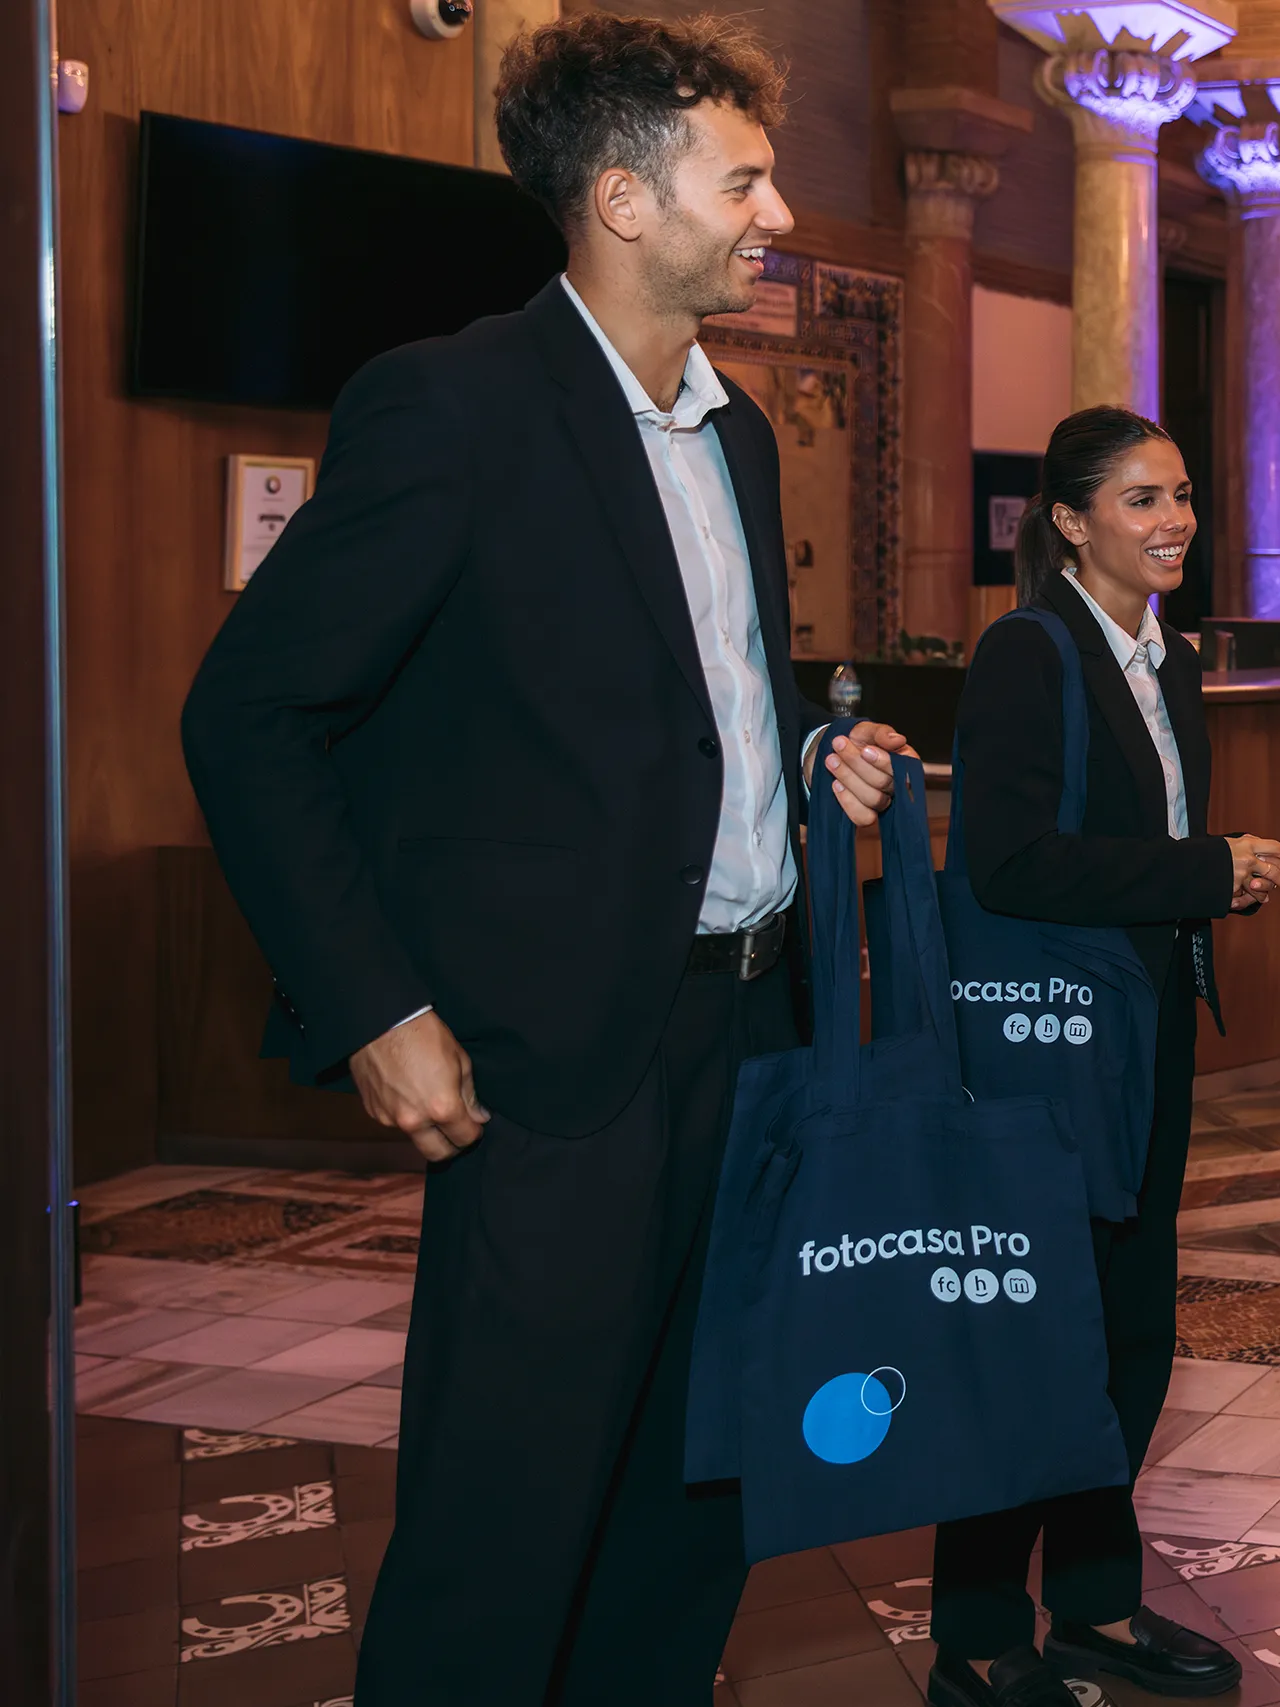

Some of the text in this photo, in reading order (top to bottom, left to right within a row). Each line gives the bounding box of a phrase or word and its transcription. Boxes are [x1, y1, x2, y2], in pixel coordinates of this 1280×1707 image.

[950, 977, 1093, 1006] ocasa Pro
[799, 1225, 1030, 1276] fotocasa Pro
